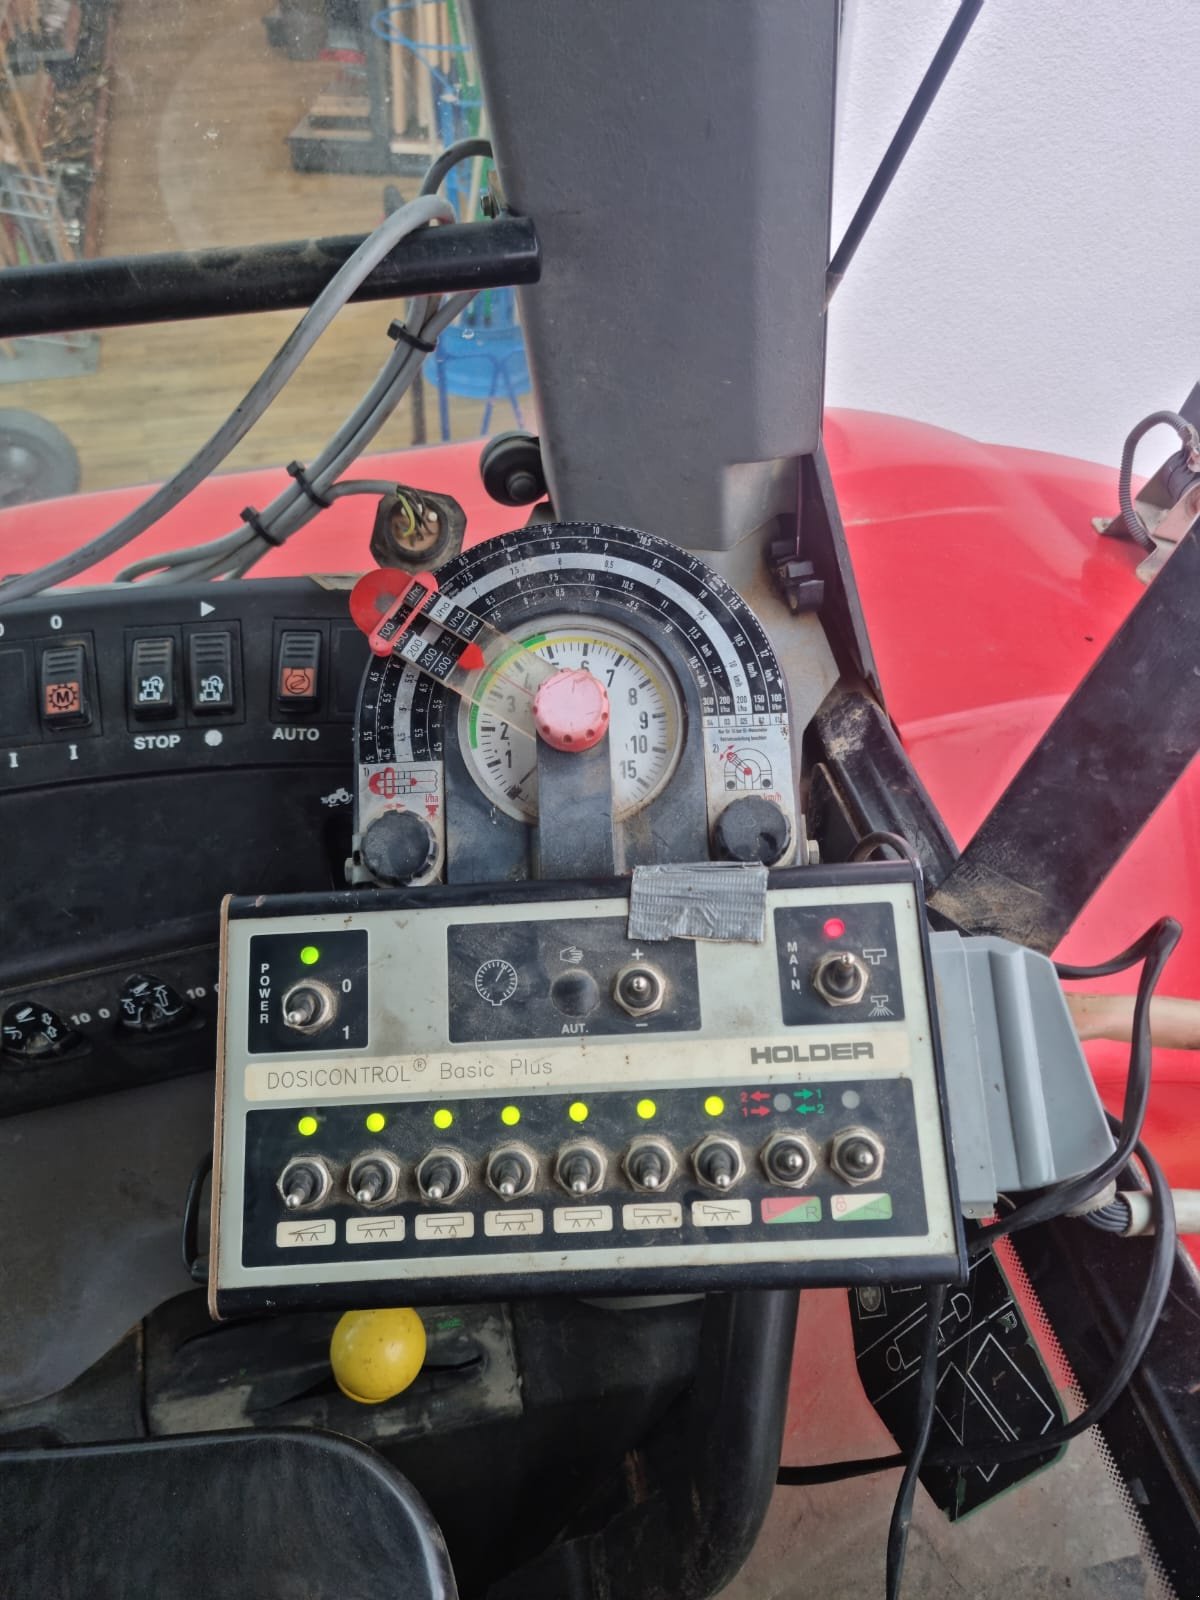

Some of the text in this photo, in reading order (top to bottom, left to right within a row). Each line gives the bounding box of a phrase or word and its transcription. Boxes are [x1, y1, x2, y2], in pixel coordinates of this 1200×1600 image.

[543, 527, 553, 535] 9.5
[406, 639, 424, 658] 200
[421, 647, 438, 667] 200
[435, 656, 452, 676] 300
[606, 669, 615, 688] 7
[507, 695, 515, 713] 3
[628, 688, 638, 706] 8
[719, 696, 730, 704] 200
[736, 696, 748, 704] 200
[753, 694, 765, 703] 150
[639, 712, 648, 730] 9
[272, 728, 320, 742] AUTO
[500, 722, 509, 740] 2
[134, 735, 181, 750] STOP
[631, 735, 648, 754] 10
[505, 750, 512, 768] 1
[620, 760, 638, 779] 15
[787, 940, 801, 991] MAIN
[187, 987, 206, 999] 10
[258, 963, 271, 1024] POWER
[342, 978, 352, 993] 0
[71, 1013, 91, 1025] 10
[98, 1008, 111, 1018] 0
[342, 1025, 350, 1040] 1
[561, 1023, 589, 1035] AUT.
[751, 1042, 874, 1065] HOLDER
[440, 1061, 495, 1081] Basic
[510, 1058, 553, 1076] Plus
[816, 1089, 822, 1098] 1
[816, 1104, 824, 1114] 2
[805, 1206, 819, 1220] R
